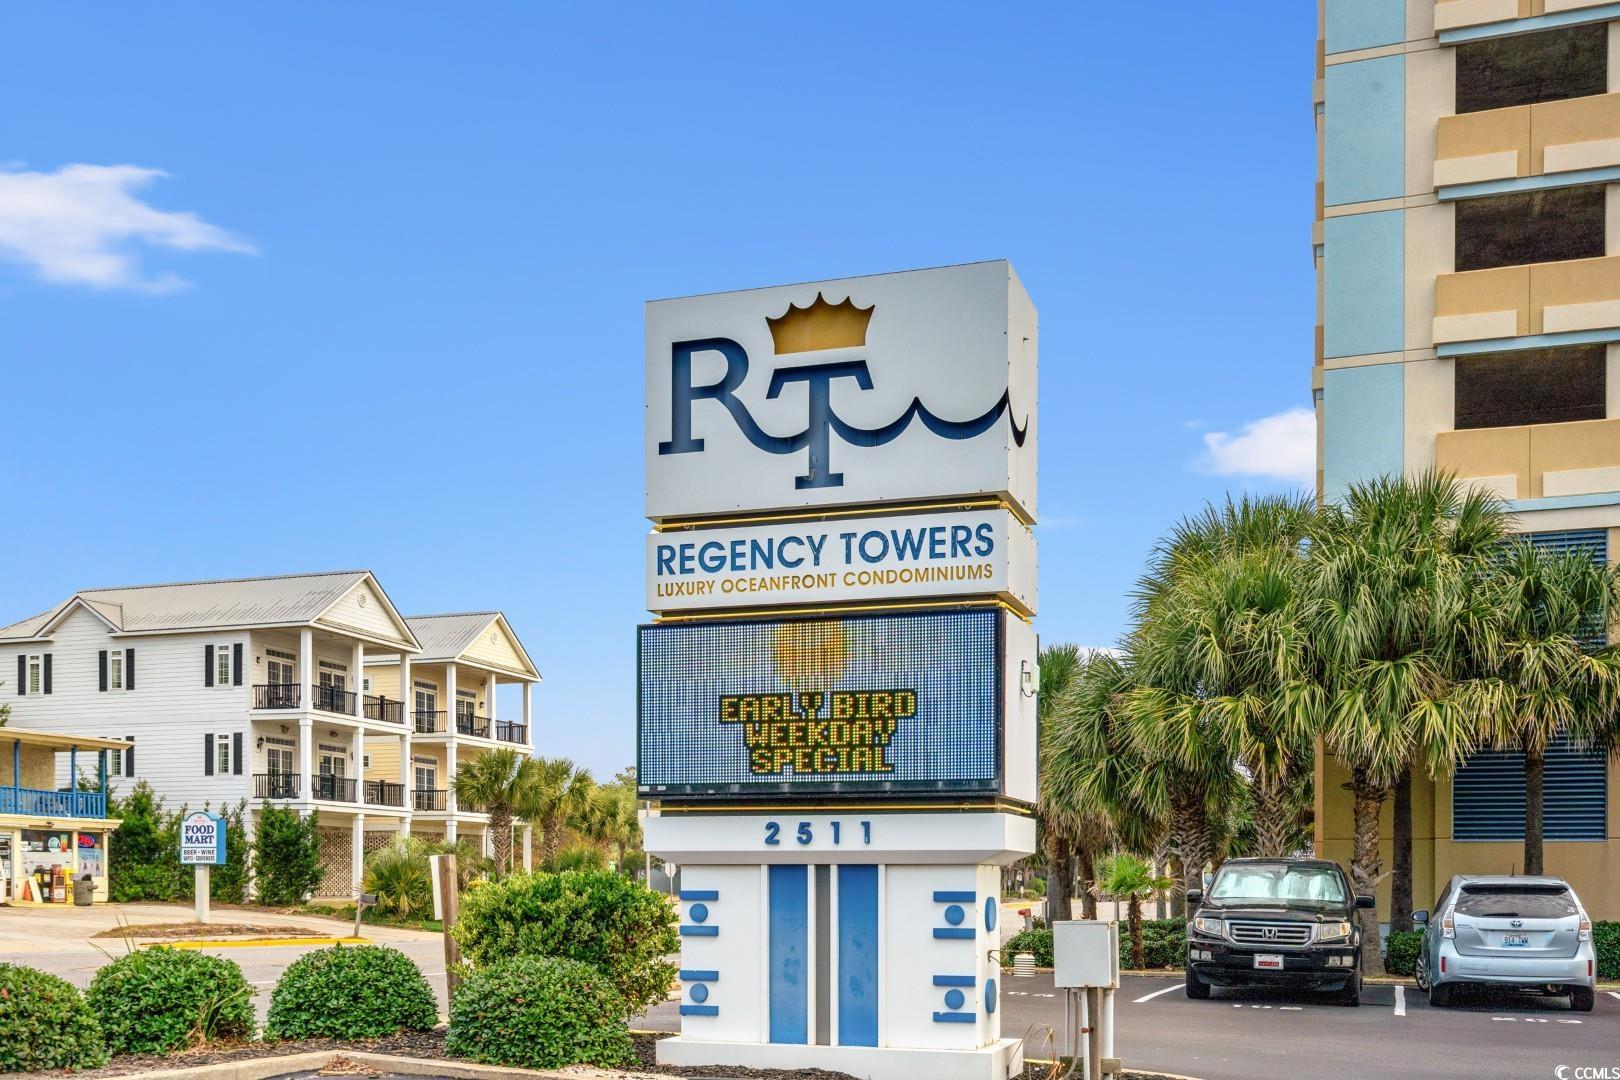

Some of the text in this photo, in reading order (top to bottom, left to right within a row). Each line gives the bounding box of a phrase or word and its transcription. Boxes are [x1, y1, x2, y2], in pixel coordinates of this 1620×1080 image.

[657, 522, 994, 575] REGENCY TOWERS
[657, 563, 993, 597] LUXURY OCEANFRONT CONDOMINIUMS
[721, 692, 916, 722] EARLY BIRD
[746, 719, 896, 747] WEEKDAY
[751, 748, 894, 773] SPECIAL
[184, 825, 214, 834] FOOD
[184, 835, 214, 844] MART
